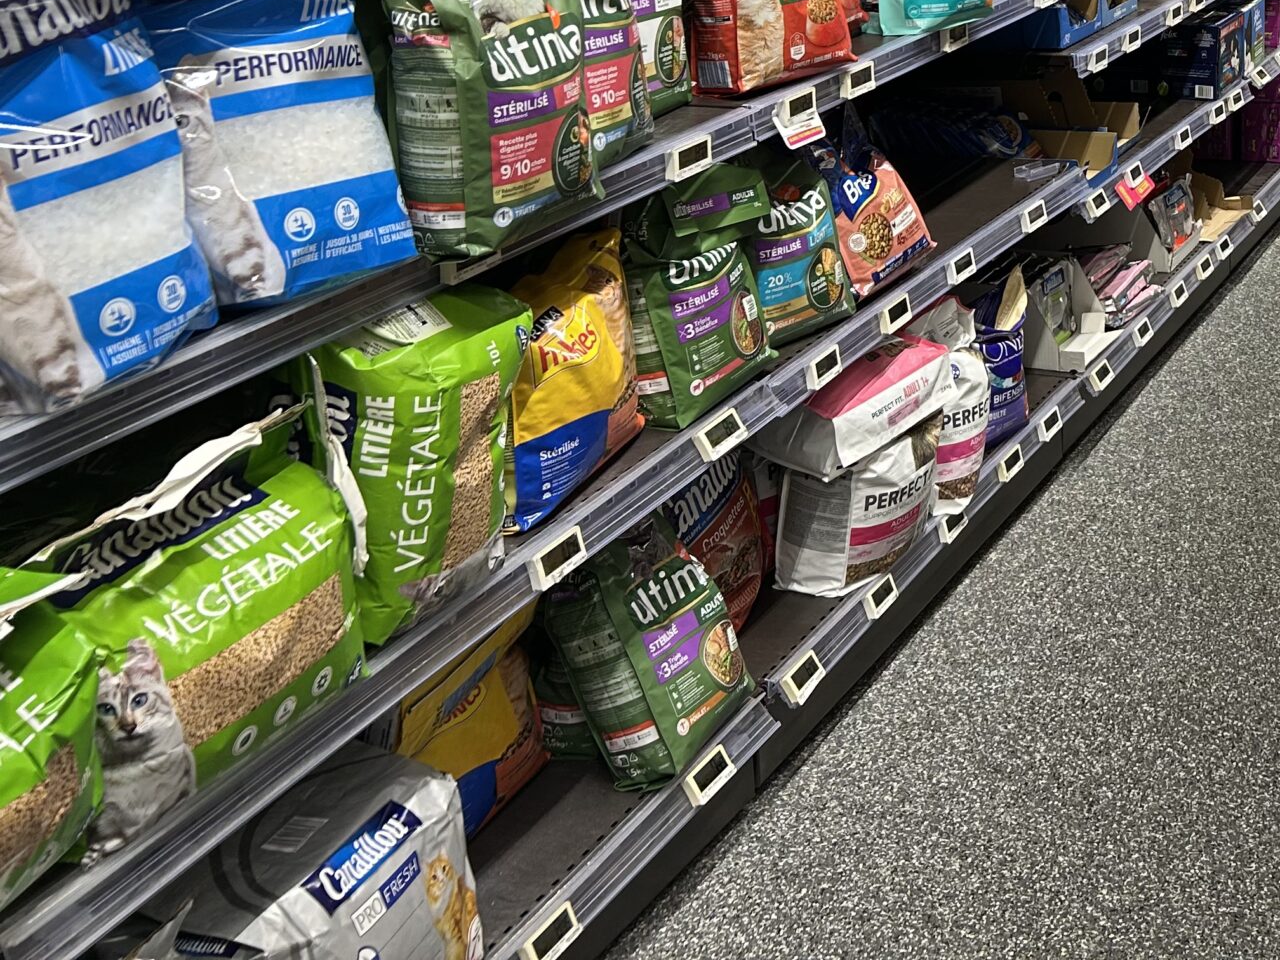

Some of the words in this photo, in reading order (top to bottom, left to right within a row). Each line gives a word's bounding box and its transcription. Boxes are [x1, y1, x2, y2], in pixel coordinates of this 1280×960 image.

[585, 29, 625, 52] TÉRILISÉ
[215, 40, 364, 87] PERFORMANCE
[493, 93, 550, 119] STÉRILISÉ
[591, 89, 616, 108] 9/10
[9, 98, 175, 171] PERFORMANCE
[499, 135, 526, 148] Recette
[526, 131, 538, 143] plus
[499, 142, 525, 155] digeste
[524, 138, 538, 151] pour
[500, 158, 532, 180] 9/10
[342, 203, 352, 216] 30
[292, 251, 319, 269] ASSURÉE
[759, 240, 803, 260] STÉRILISÉ
[674, 287, 721, 313] STÉRILISÉ
[531, 307, 562, 340] RINA
[693, 314, 711, 327] Triple
[110, 344, 149, 366] ASSURÉE
[871, 400, 895, 421] PERFECT
[903, 381, 921, 401] ADULT
[357, 395, 396, 479] LITIÈRE
[539, 438, 580, 462] Stérilisé
[394, 394, 444, 574] VÉGÉTALE
[863, 470, 928, 513] PERFECT
[201, 499, 301, 562] LITIÈRE
[702, 496, 746, 552] Croquettes
[142, 519, 335, 642] VÉGÉTALE
[630, 562, 710, 625] ultim
[317, 812, 410, 904] Canaillou
[354, 899, 385, 933] PRO
[382, 858, 420, 906] FRESH
